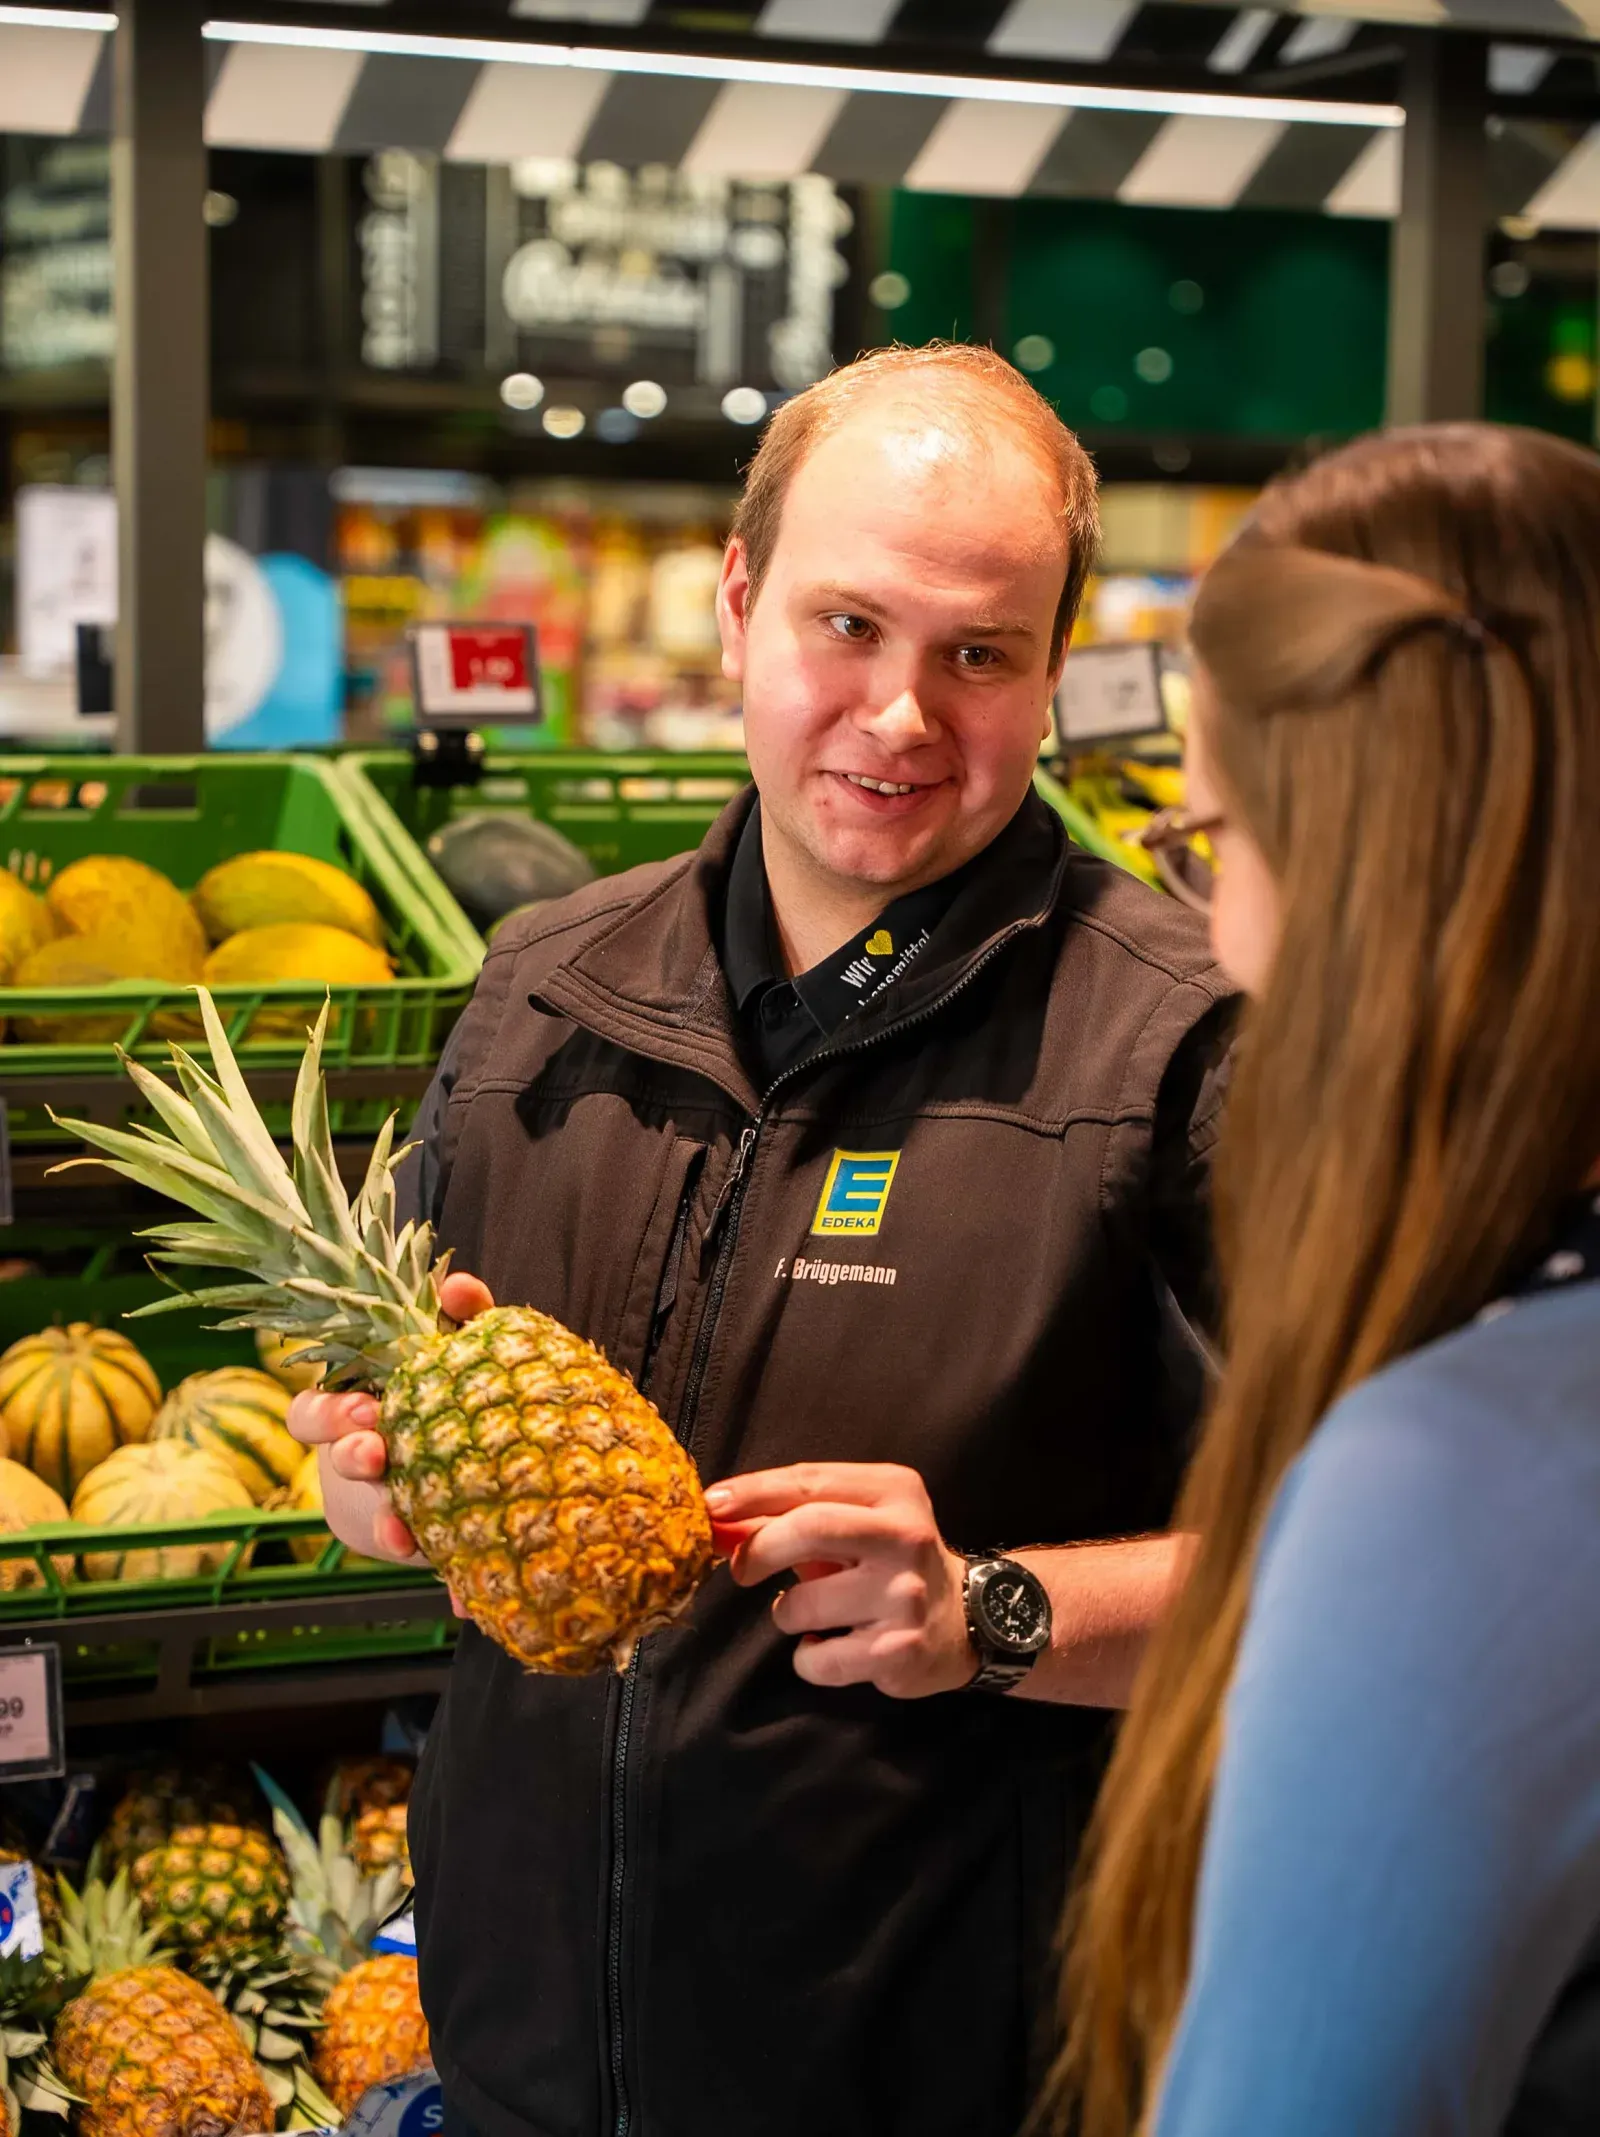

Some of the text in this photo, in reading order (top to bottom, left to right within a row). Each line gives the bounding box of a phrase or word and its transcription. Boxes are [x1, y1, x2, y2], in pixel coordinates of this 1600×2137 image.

[840, 956, 876, 988] Wir
[826, 1158, 893, 1212] E
[821, 1217, 876, 1228] EDEKA
[792, 1257, 897, 1285] Brüggemann
